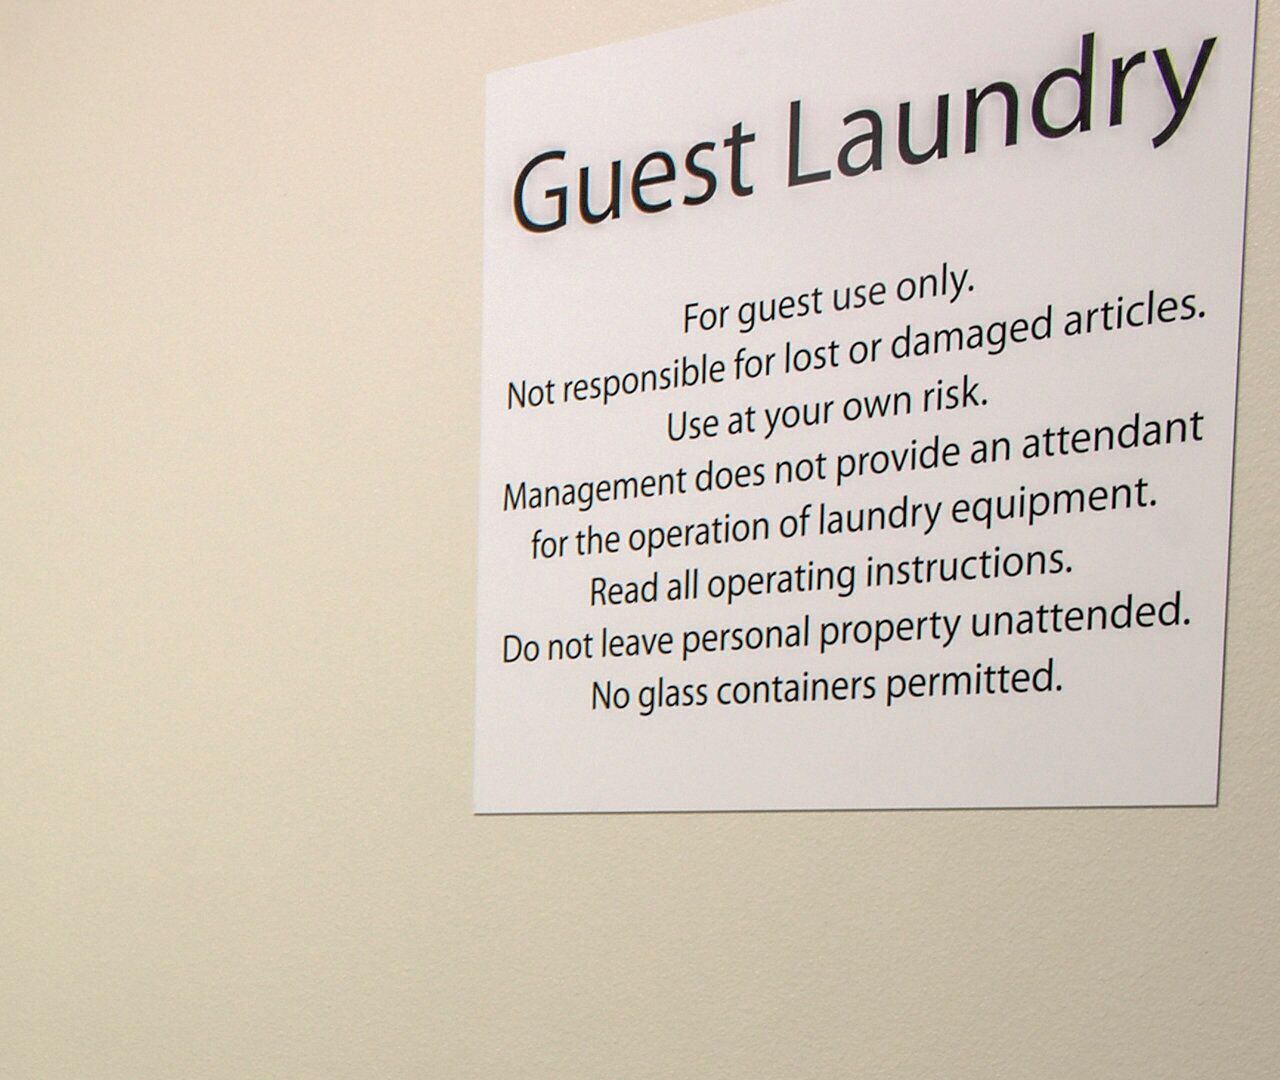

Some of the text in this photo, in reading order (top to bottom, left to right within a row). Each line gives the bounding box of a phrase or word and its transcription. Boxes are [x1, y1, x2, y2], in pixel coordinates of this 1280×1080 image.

[513, 31, 1218, 233] Guest Laundry
[684, 262, 974, 334] For guest use only.
[508, 289, 1205, 410] Not responsible for lost or damaged articles.
[668, 374, 988, 442] Use at your own risk.
[503, 411, 1205, 512] Management does not provide an attendant
[531, 477, 1157, 559] for the operation of laundry equipment.
[591, 546, 1072, 606] Read all operating instructions.
[503, 590, 1190, 663] Do not leave personal property unattended.
[592, 657, 1062, 717] No glass containers permitted.
